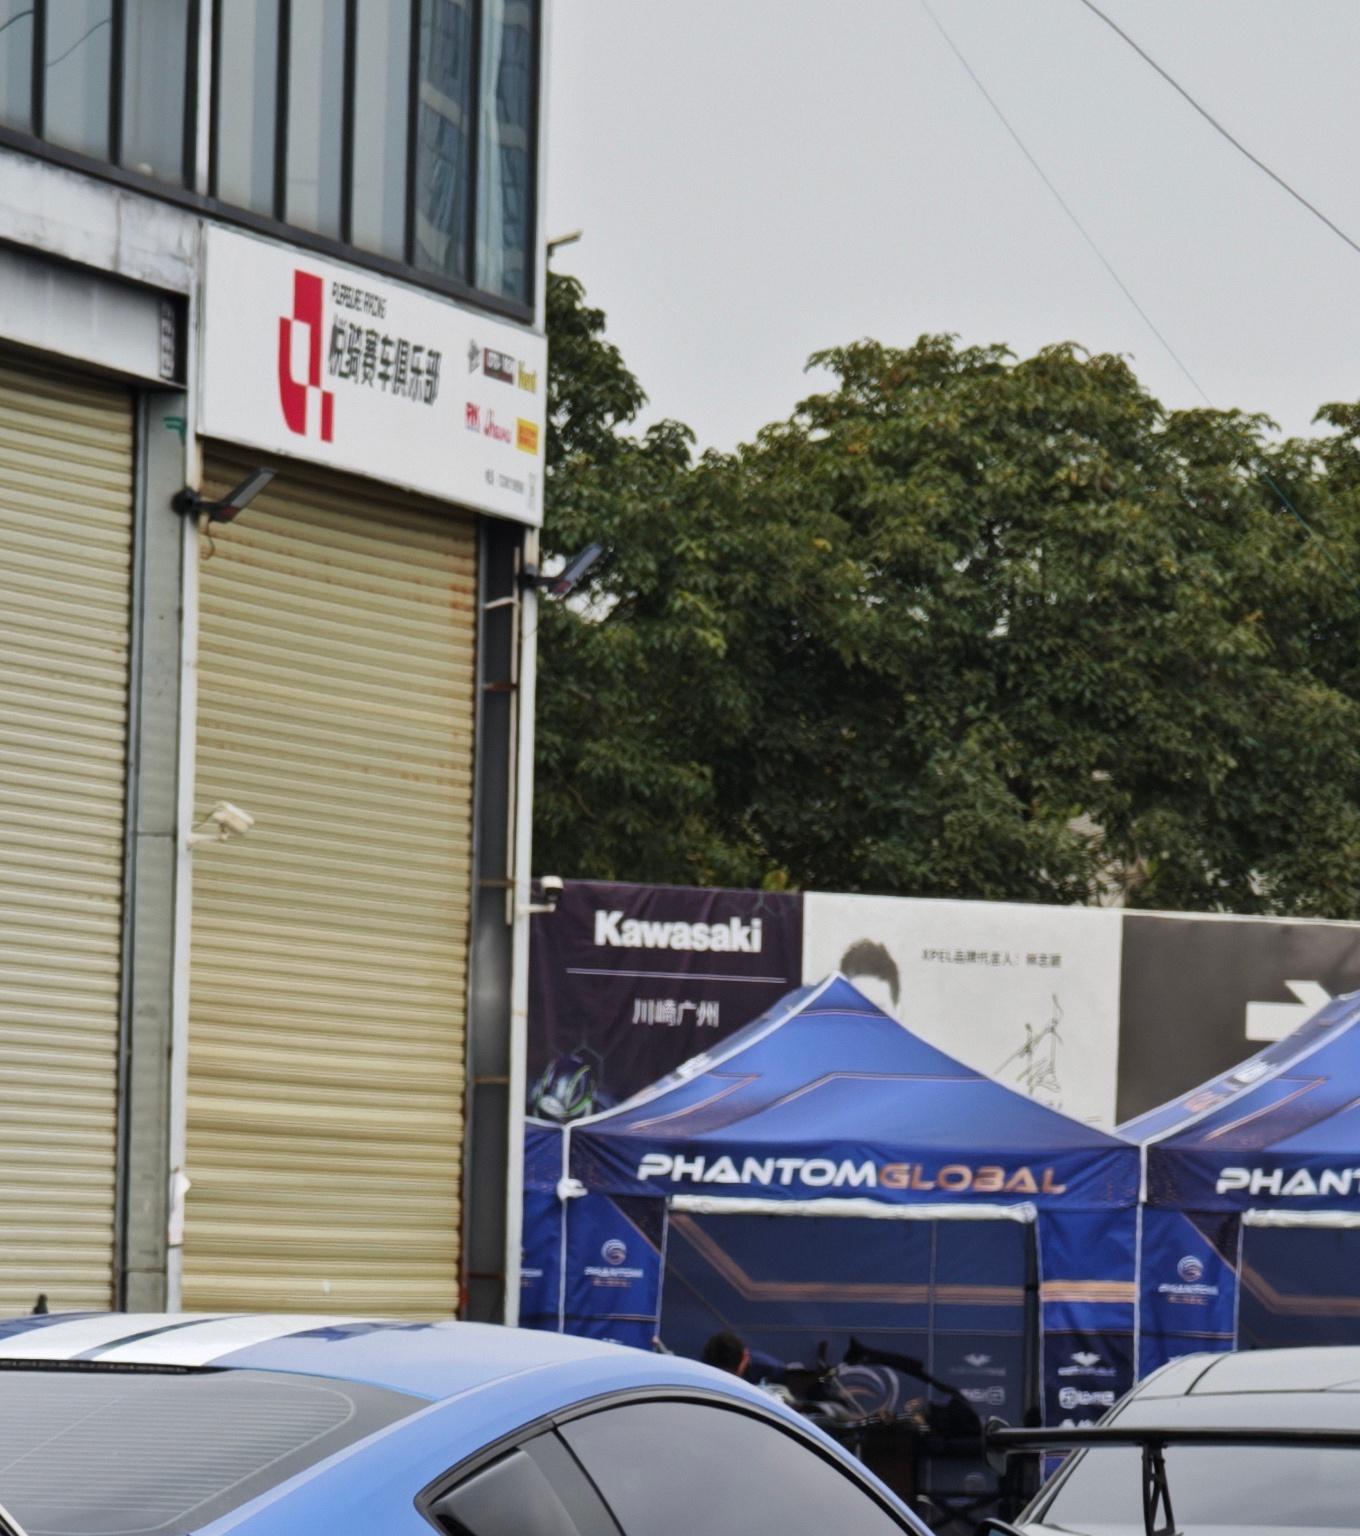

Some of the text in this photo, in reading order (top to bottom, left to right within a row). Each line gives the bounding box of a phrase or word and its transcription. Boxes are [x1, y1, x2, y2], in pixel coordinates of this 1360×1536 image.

[594, 909, 762, 953] Kawasaki
[632, 999, 719, 1028] 川崎广州
